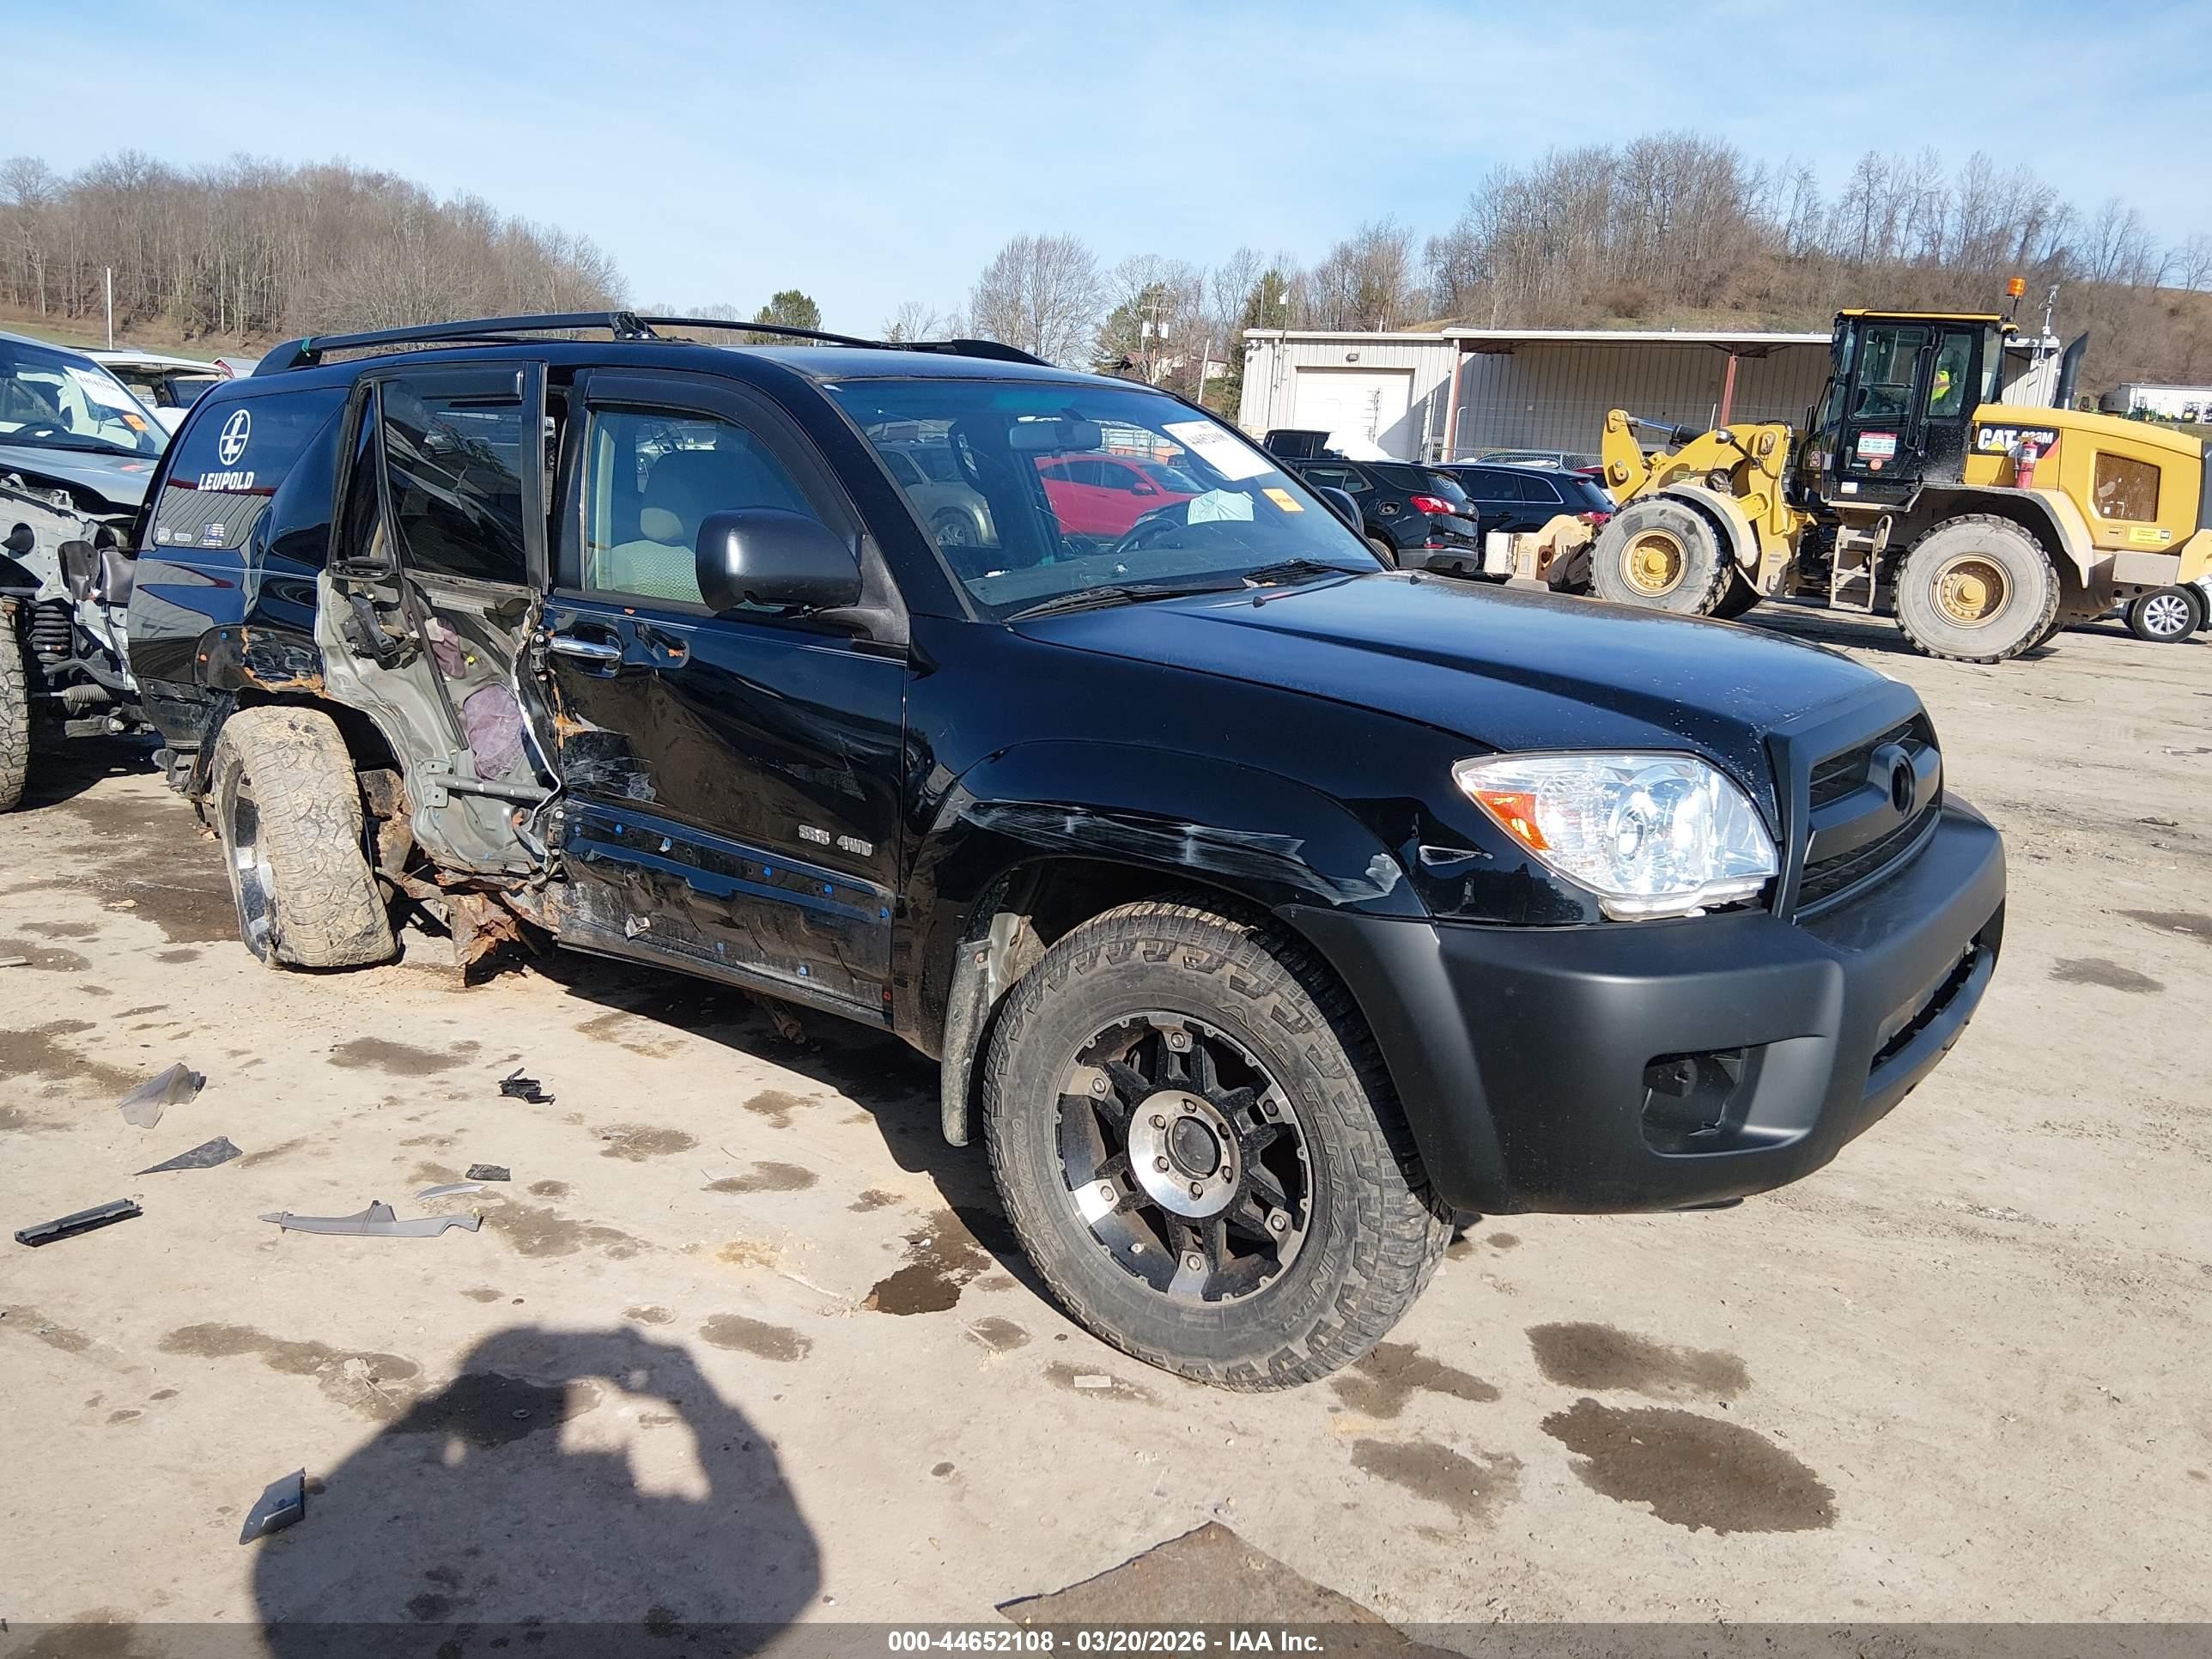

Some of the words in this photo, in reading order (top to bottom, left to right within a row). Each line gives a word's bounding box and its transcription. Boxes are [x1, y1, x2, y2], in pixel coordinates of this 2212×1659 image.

[1978, 428, 2017, 451] CAT
[198, 471, 255, 490] LEUPOLD
[836, 835, 872, 857] 4WD
[1216, 1005, 1289, 1066] ALL
[1302, 1079, 1346, 1297] TERRAIN
